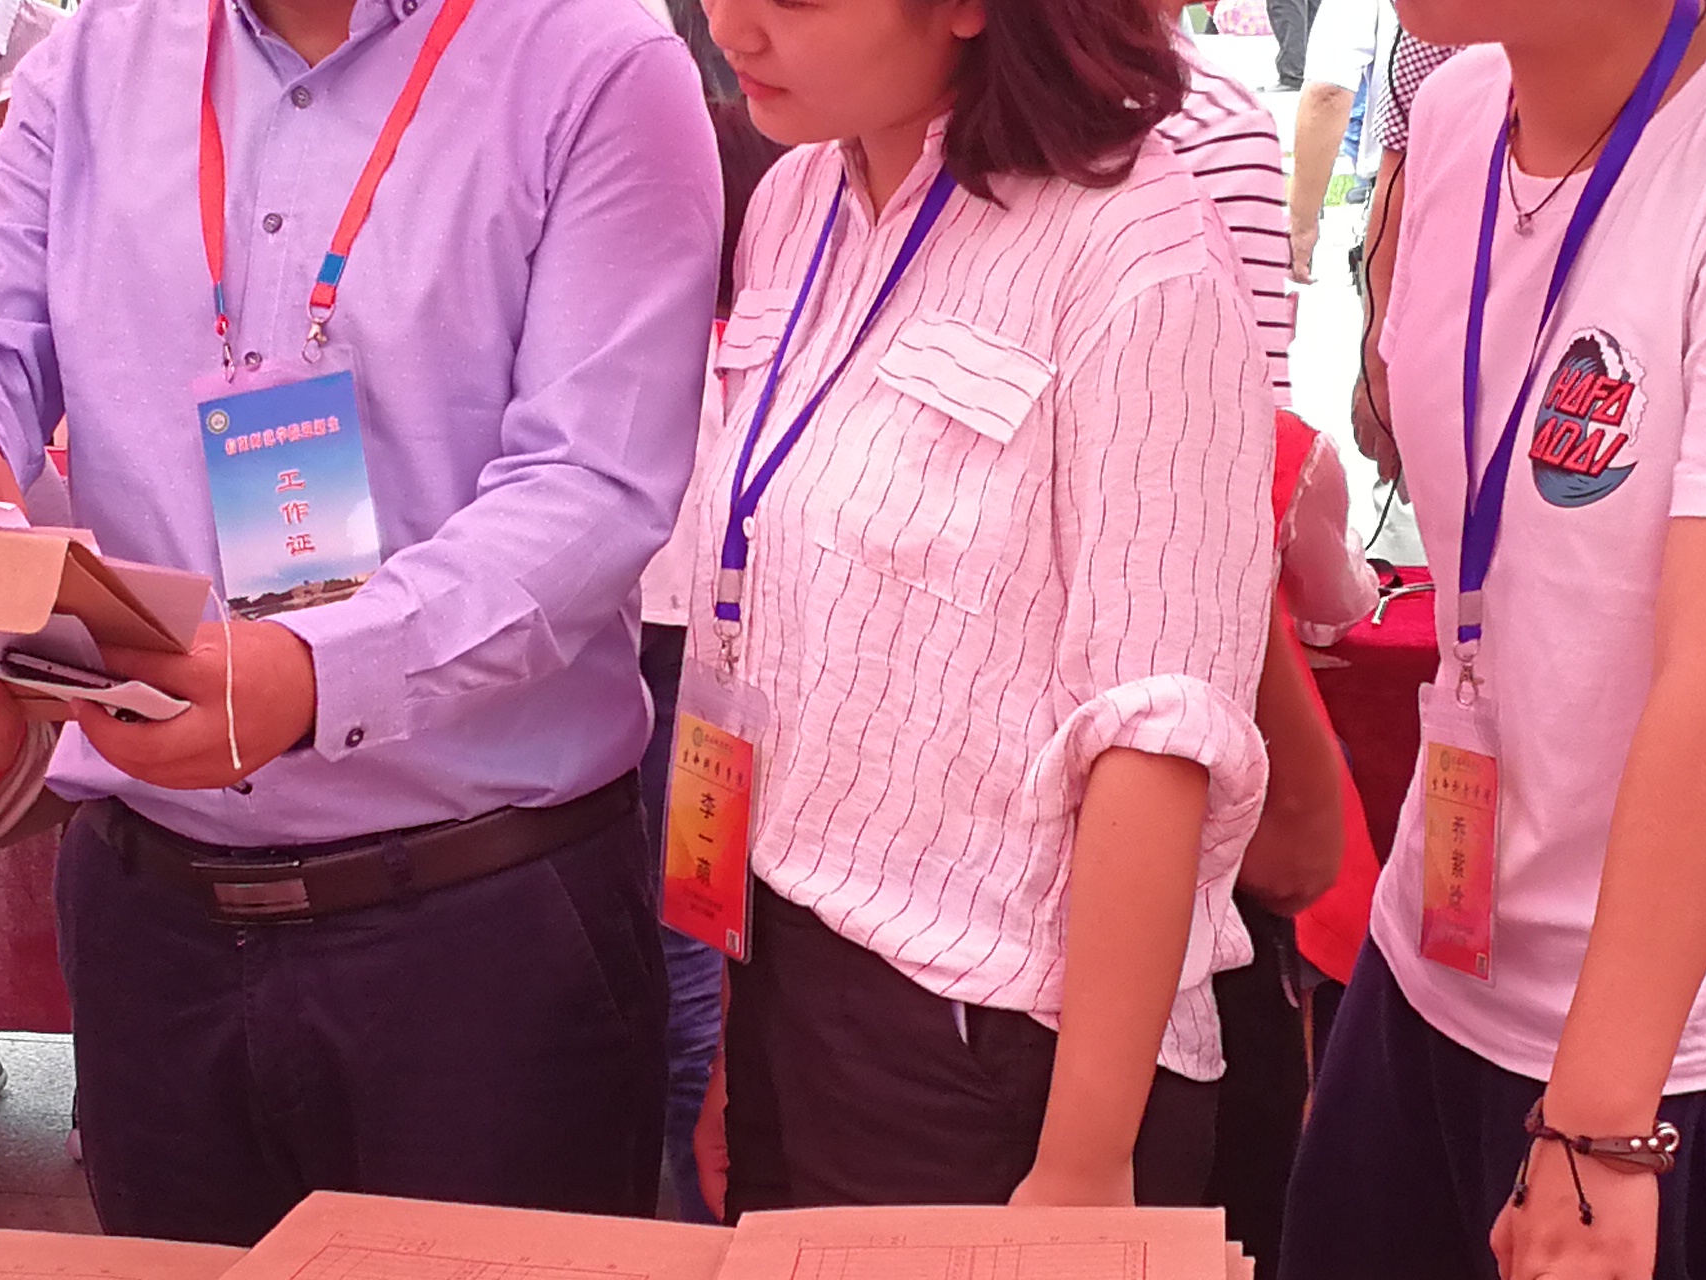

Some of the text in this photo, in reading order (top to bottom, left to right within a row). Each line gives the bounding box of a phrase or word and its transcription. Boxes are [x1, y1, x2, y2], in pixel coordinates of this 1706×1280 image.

[1545, 367, 1636, 427] HAFA
[1528, 416, 1629, 478] ADAI
[275, 468, 316, 557] 工作证
